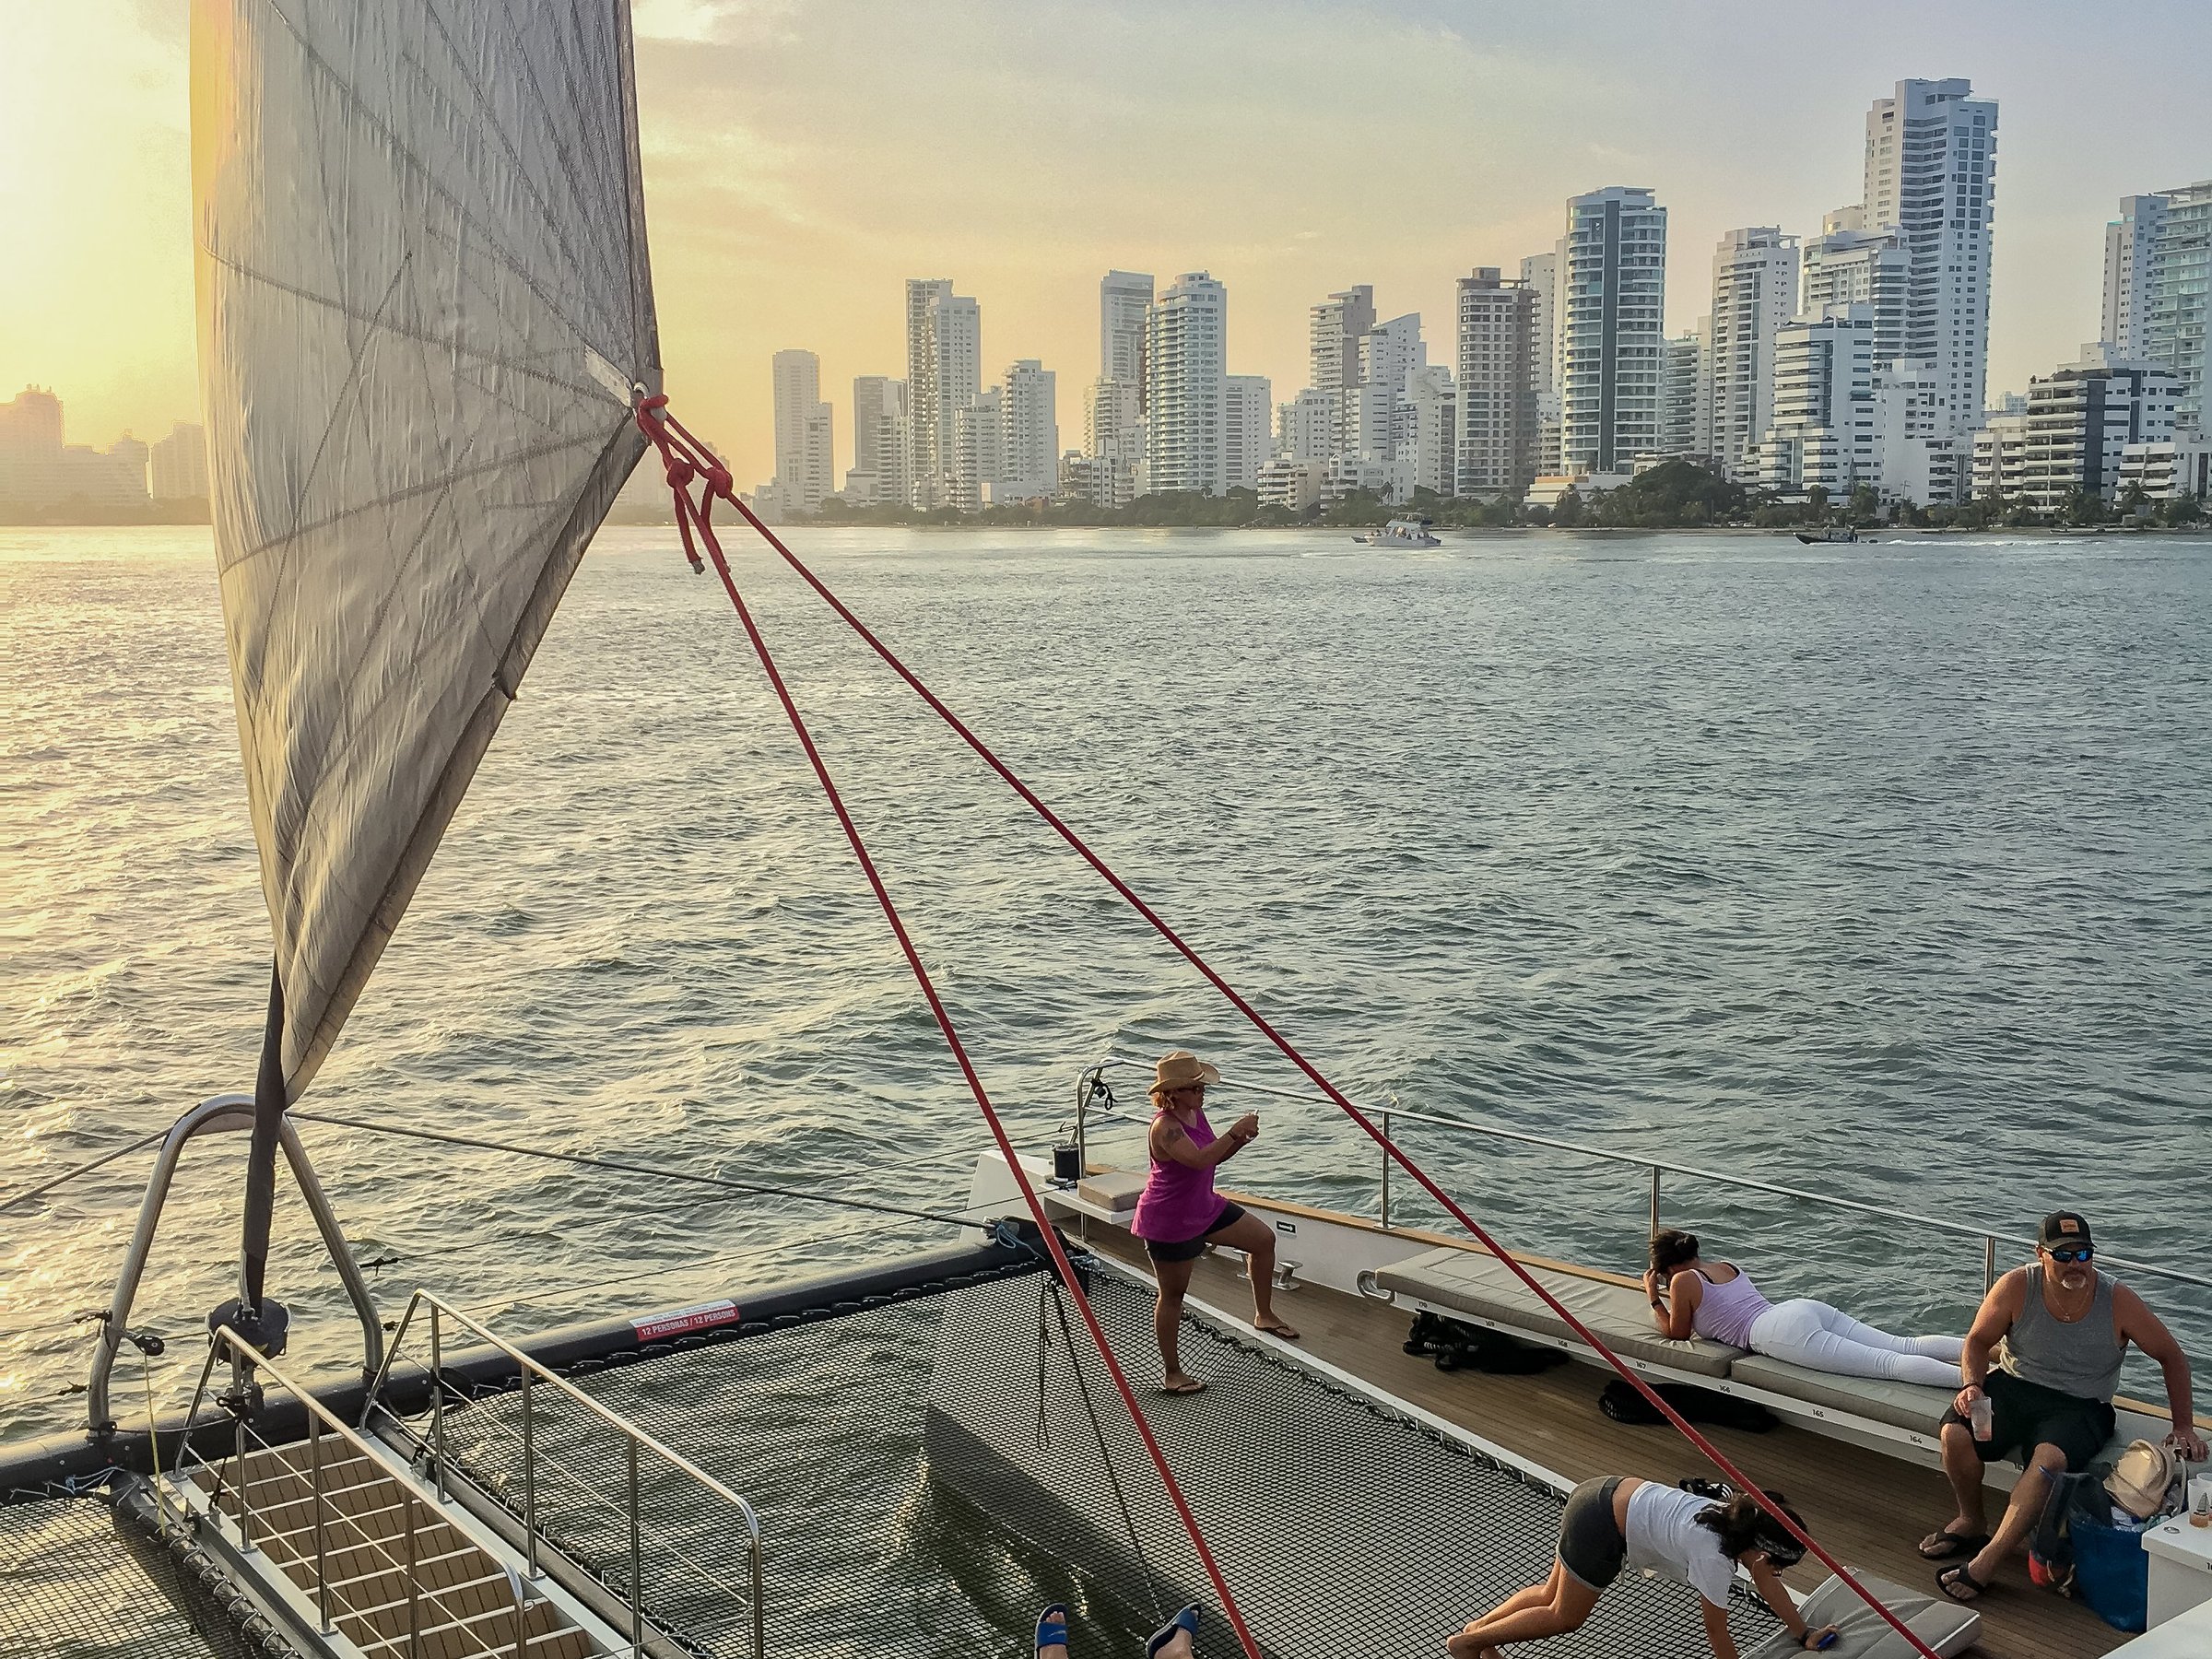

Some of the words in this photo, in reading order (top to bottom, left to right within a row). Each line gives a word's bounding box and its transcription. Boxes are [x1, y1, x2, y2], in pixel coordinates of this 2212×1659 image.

[641, 1327, 652, 1335] 12
[653, 1319, 689, 1334] PERSONAS
[694, 1316, 703, 1324] 12
[704, 1309, 735, 1323] PERSONS
[1635, 1360, 1646, 1370] 167
[1812, 1408, 1824, 1418] 165
[1909, 1434, 1923, 1444] 164
